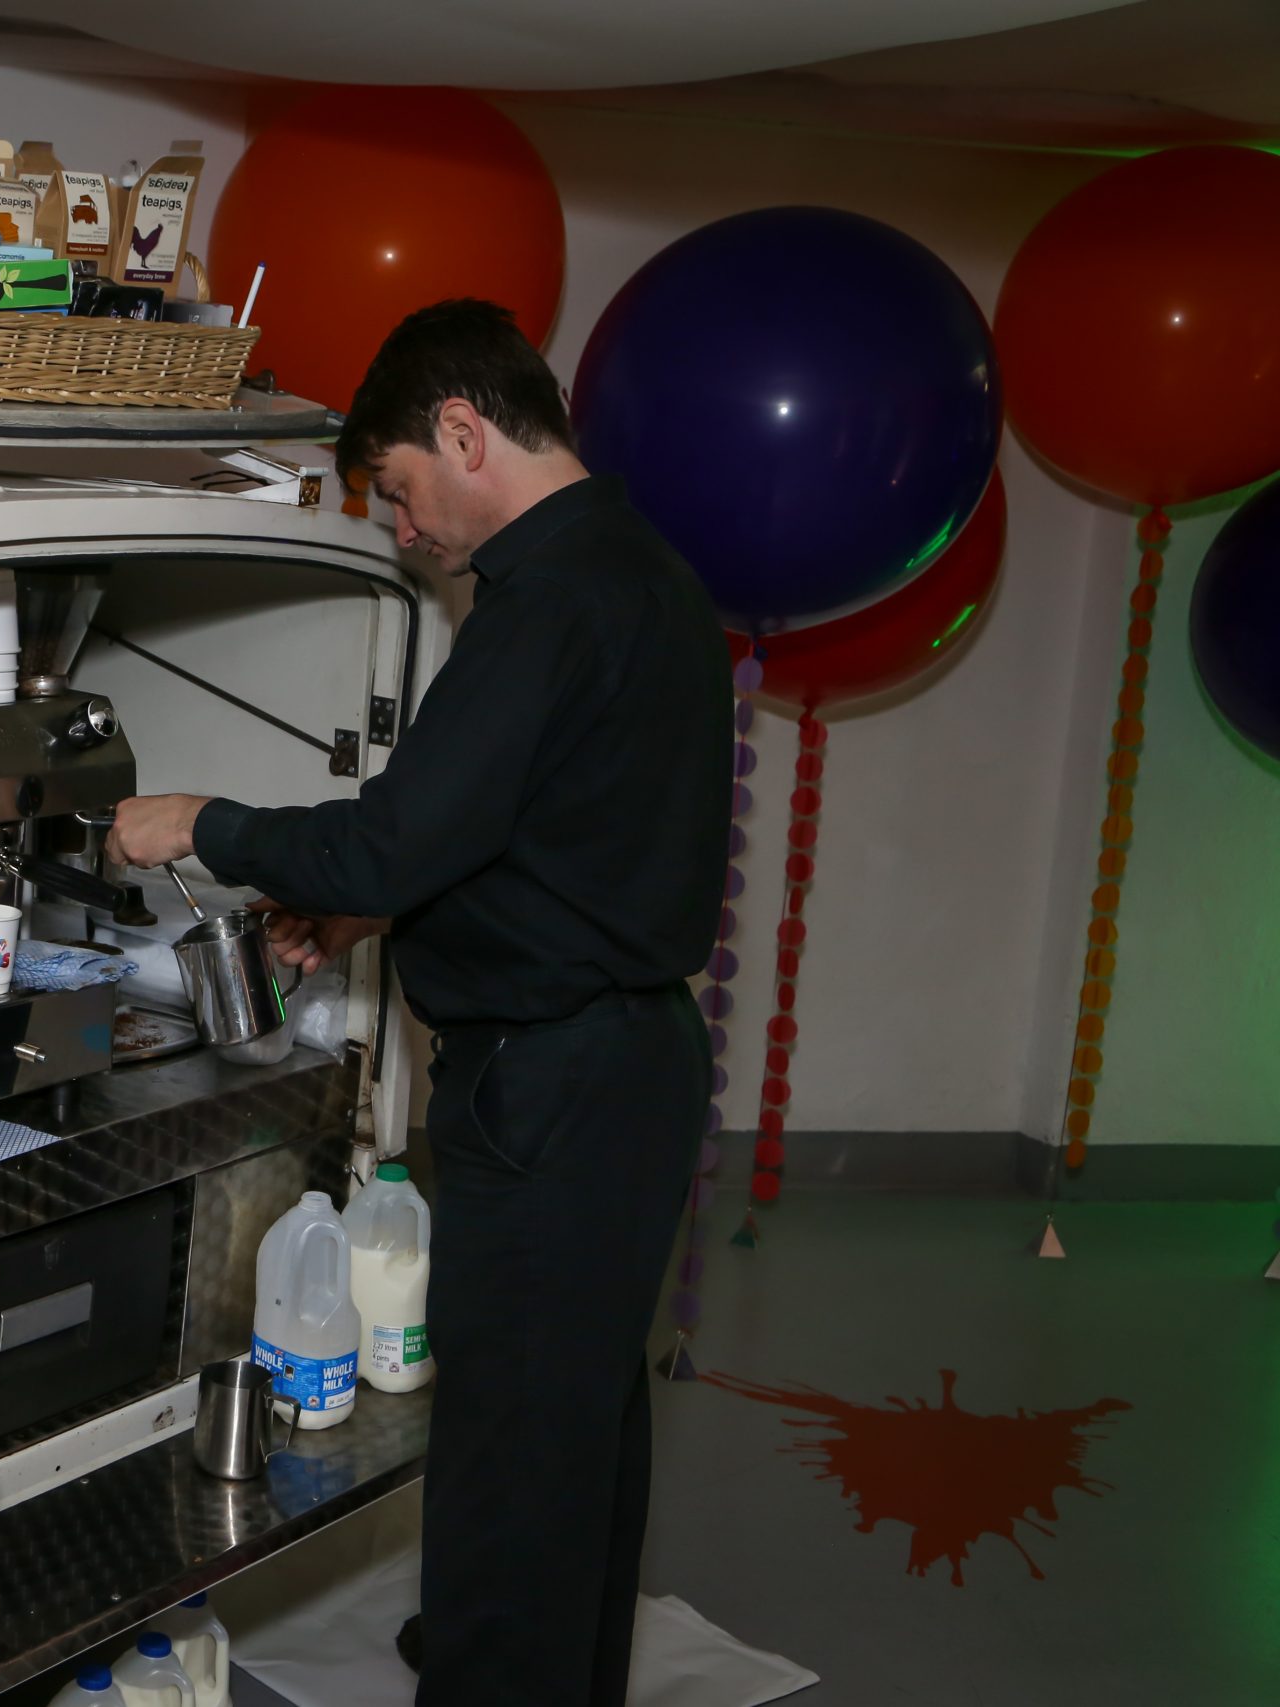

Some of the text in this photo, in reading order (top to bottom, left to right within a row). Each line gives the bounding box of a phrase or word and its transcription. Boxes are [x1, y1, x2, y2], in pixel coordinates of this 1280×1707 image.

[142, 194, 184, 212] teapigs.
[255, 1344, 284, 1371] WHOLE
[323, 1361, 354, 1380] WHOLE
[323, 1377, 344, 1391] MILK
